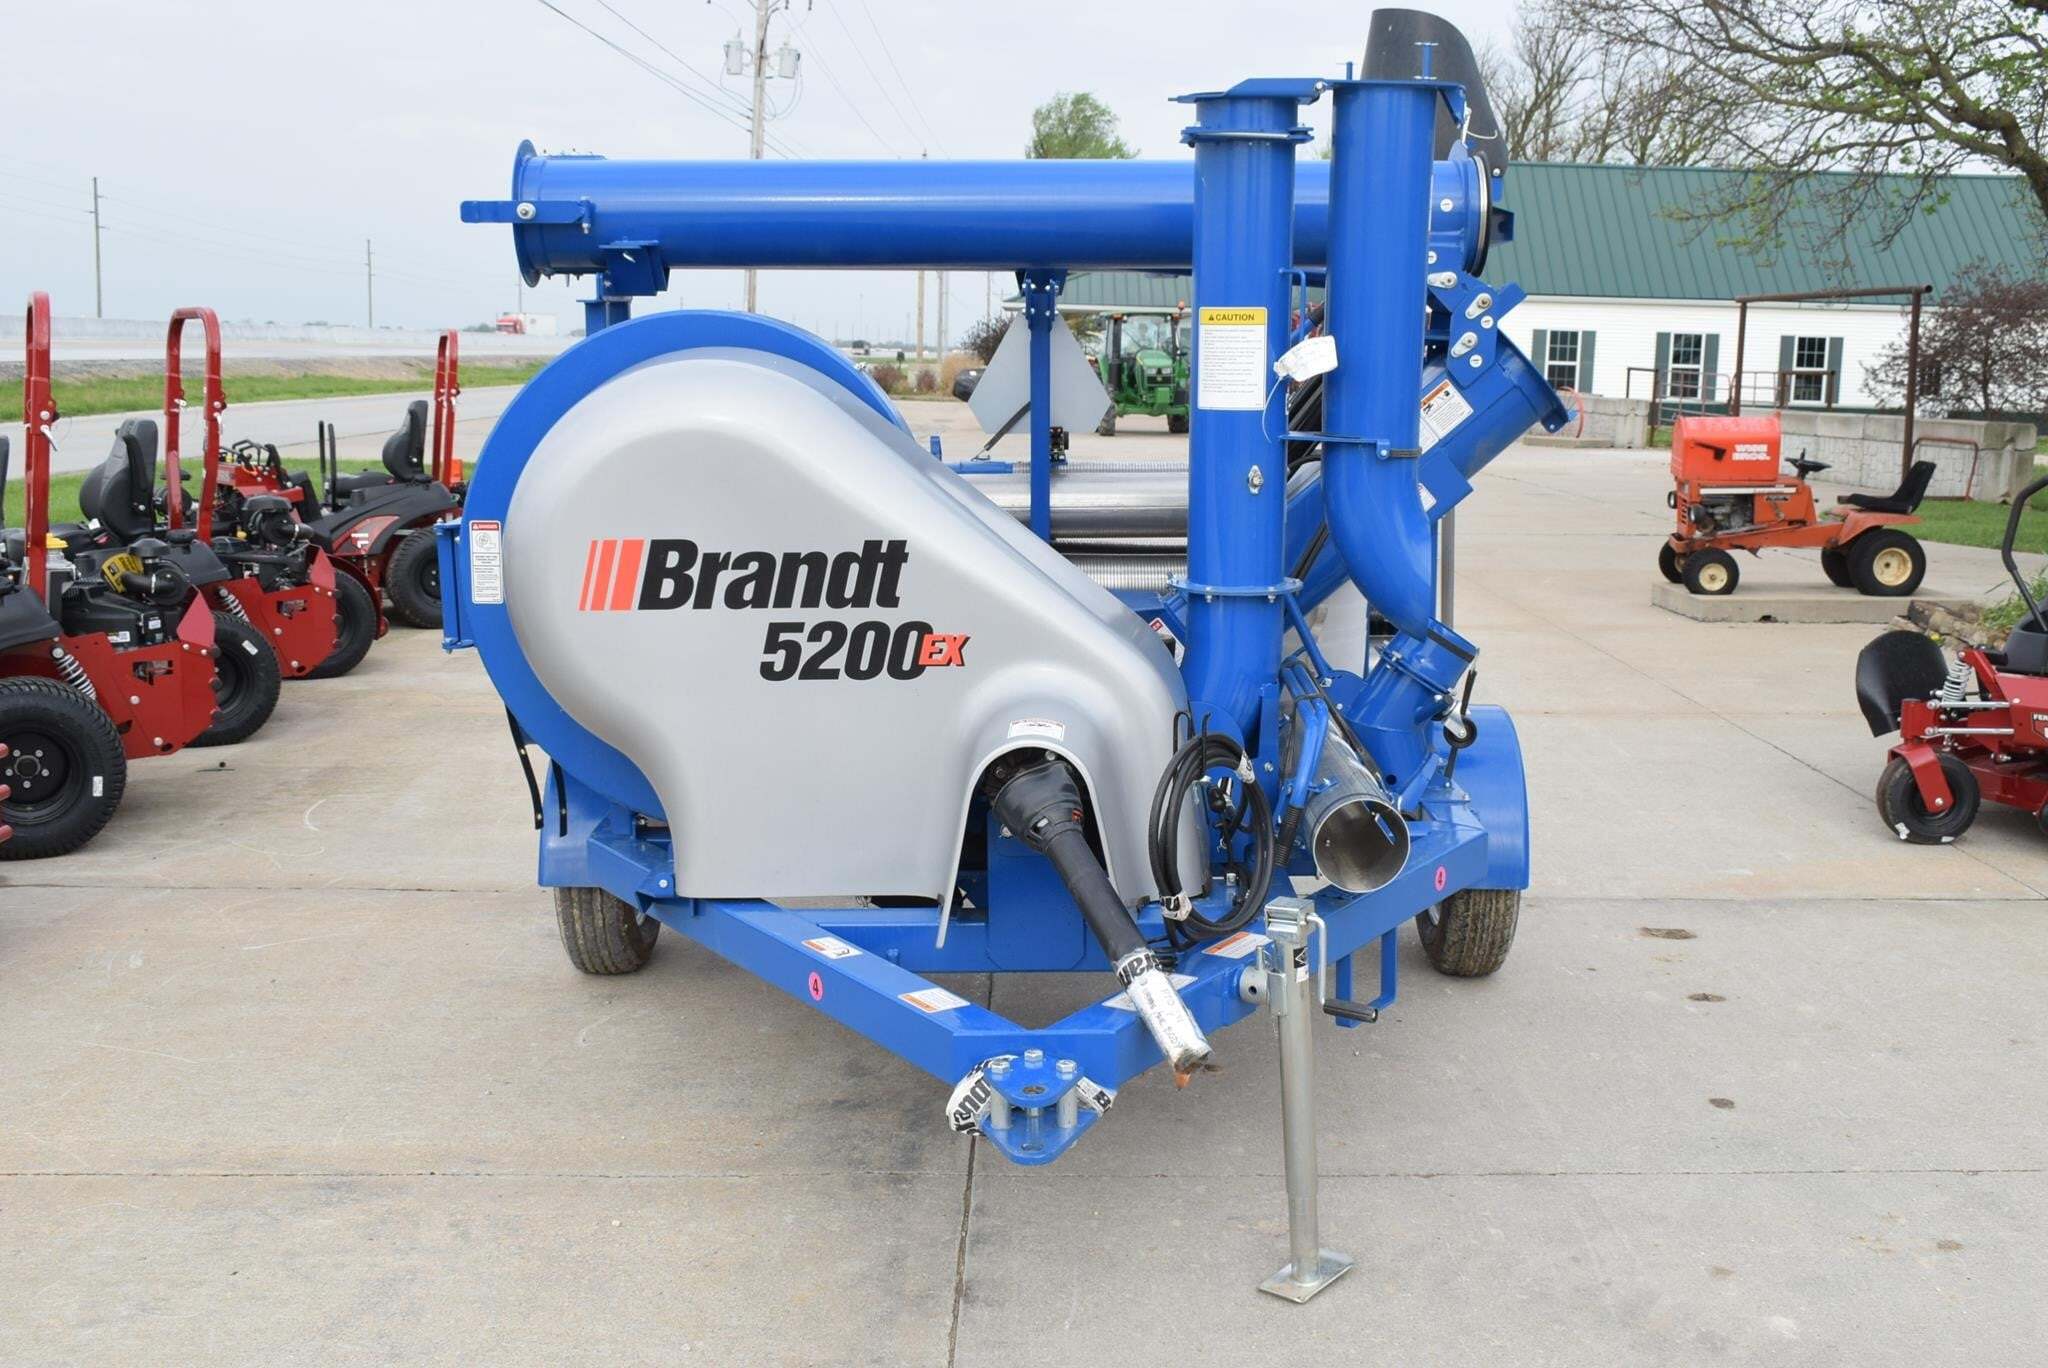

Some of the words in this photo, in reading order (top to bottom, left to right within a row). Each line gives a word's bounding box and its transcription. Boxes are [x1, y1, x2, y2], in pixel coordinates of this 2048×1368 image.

[1215, 313, 1255, 322] CAUTION
[638, 538, 909, 610] Brandt
[812, 978, 819, 995] 4
